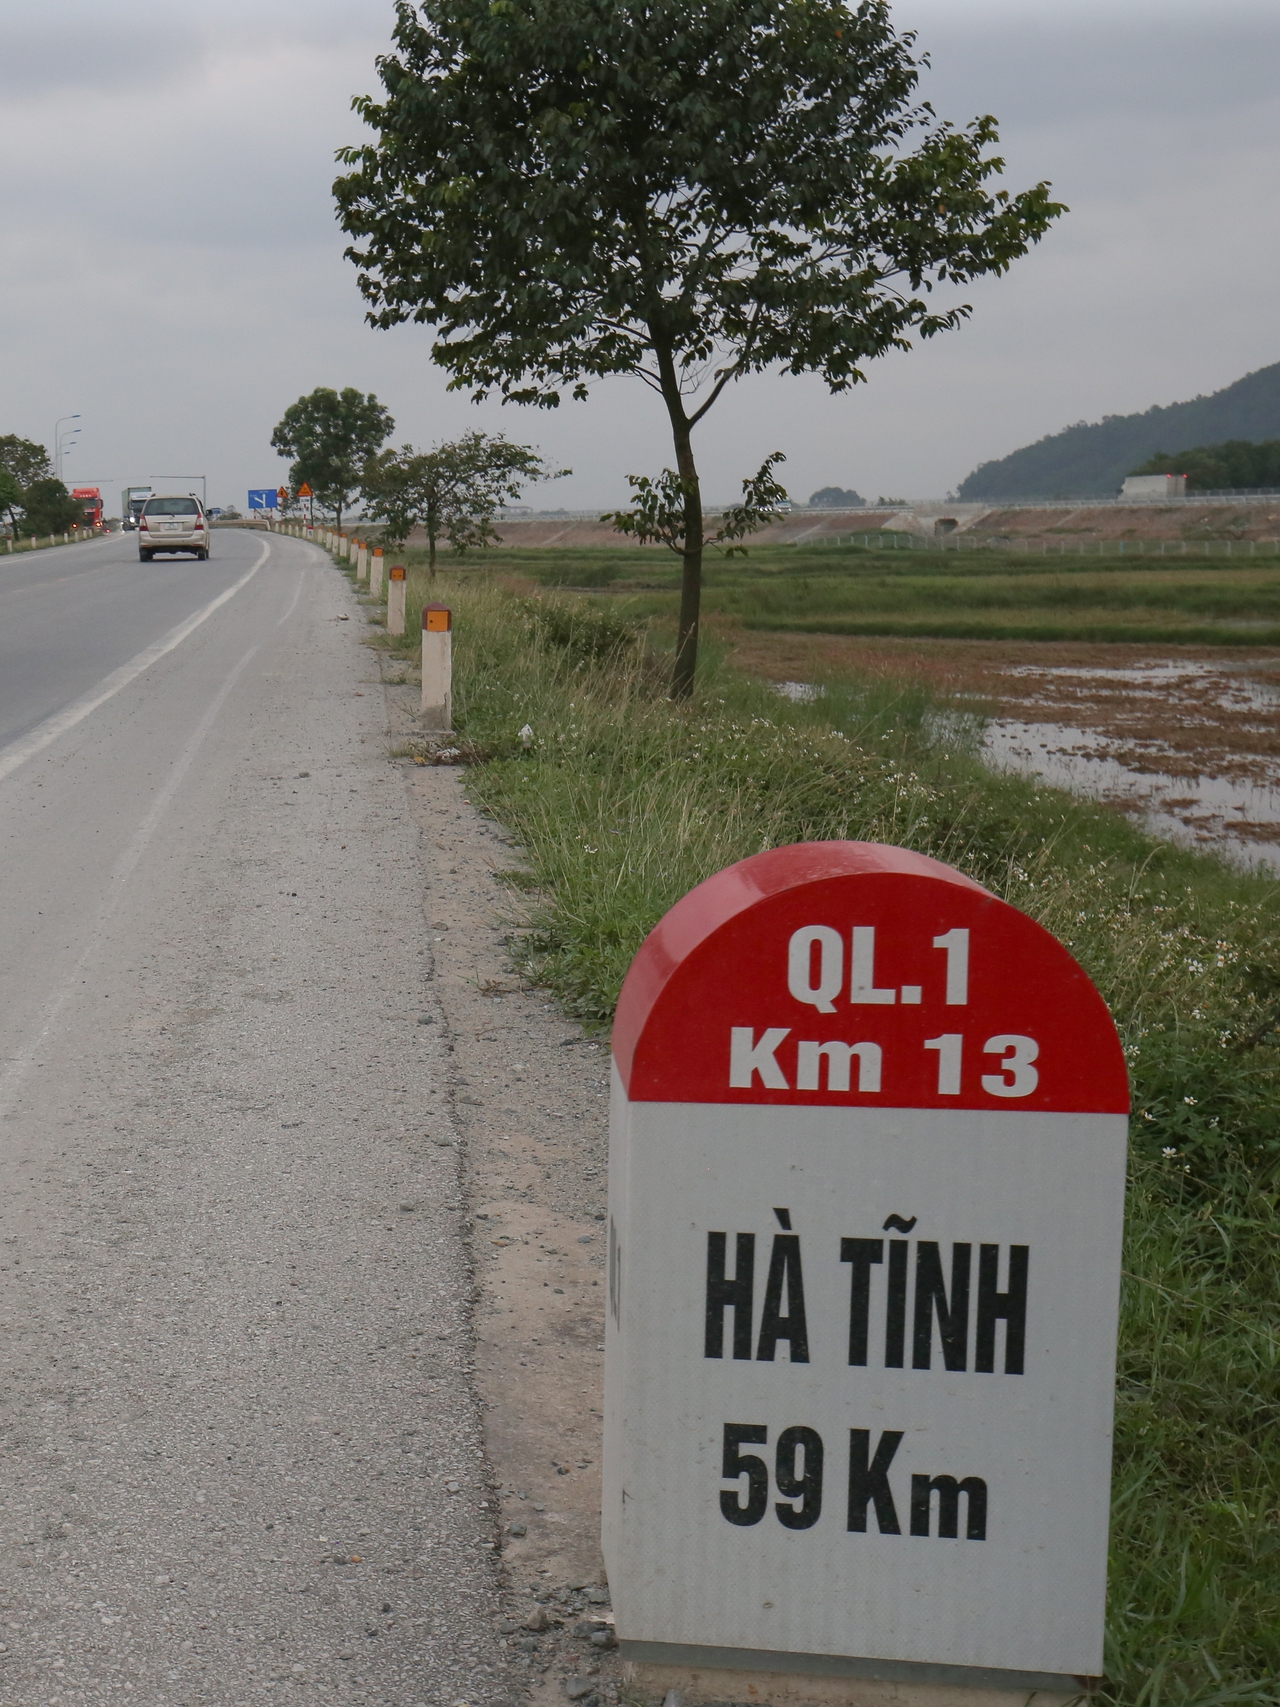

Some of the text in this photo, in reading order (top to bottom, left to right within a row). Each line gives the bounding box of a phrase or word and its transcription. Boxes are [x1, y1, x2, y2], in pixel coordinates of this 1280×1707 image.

[788, 925, 969, 1014] QL.1
[729, 1026, 1039, 1098] Km 13
[704, 1207, 811, 1364] HÀ
[839, 1213, 1030, 1376] TĨNH
[719, 1422, 988, 1542] 59 Km
